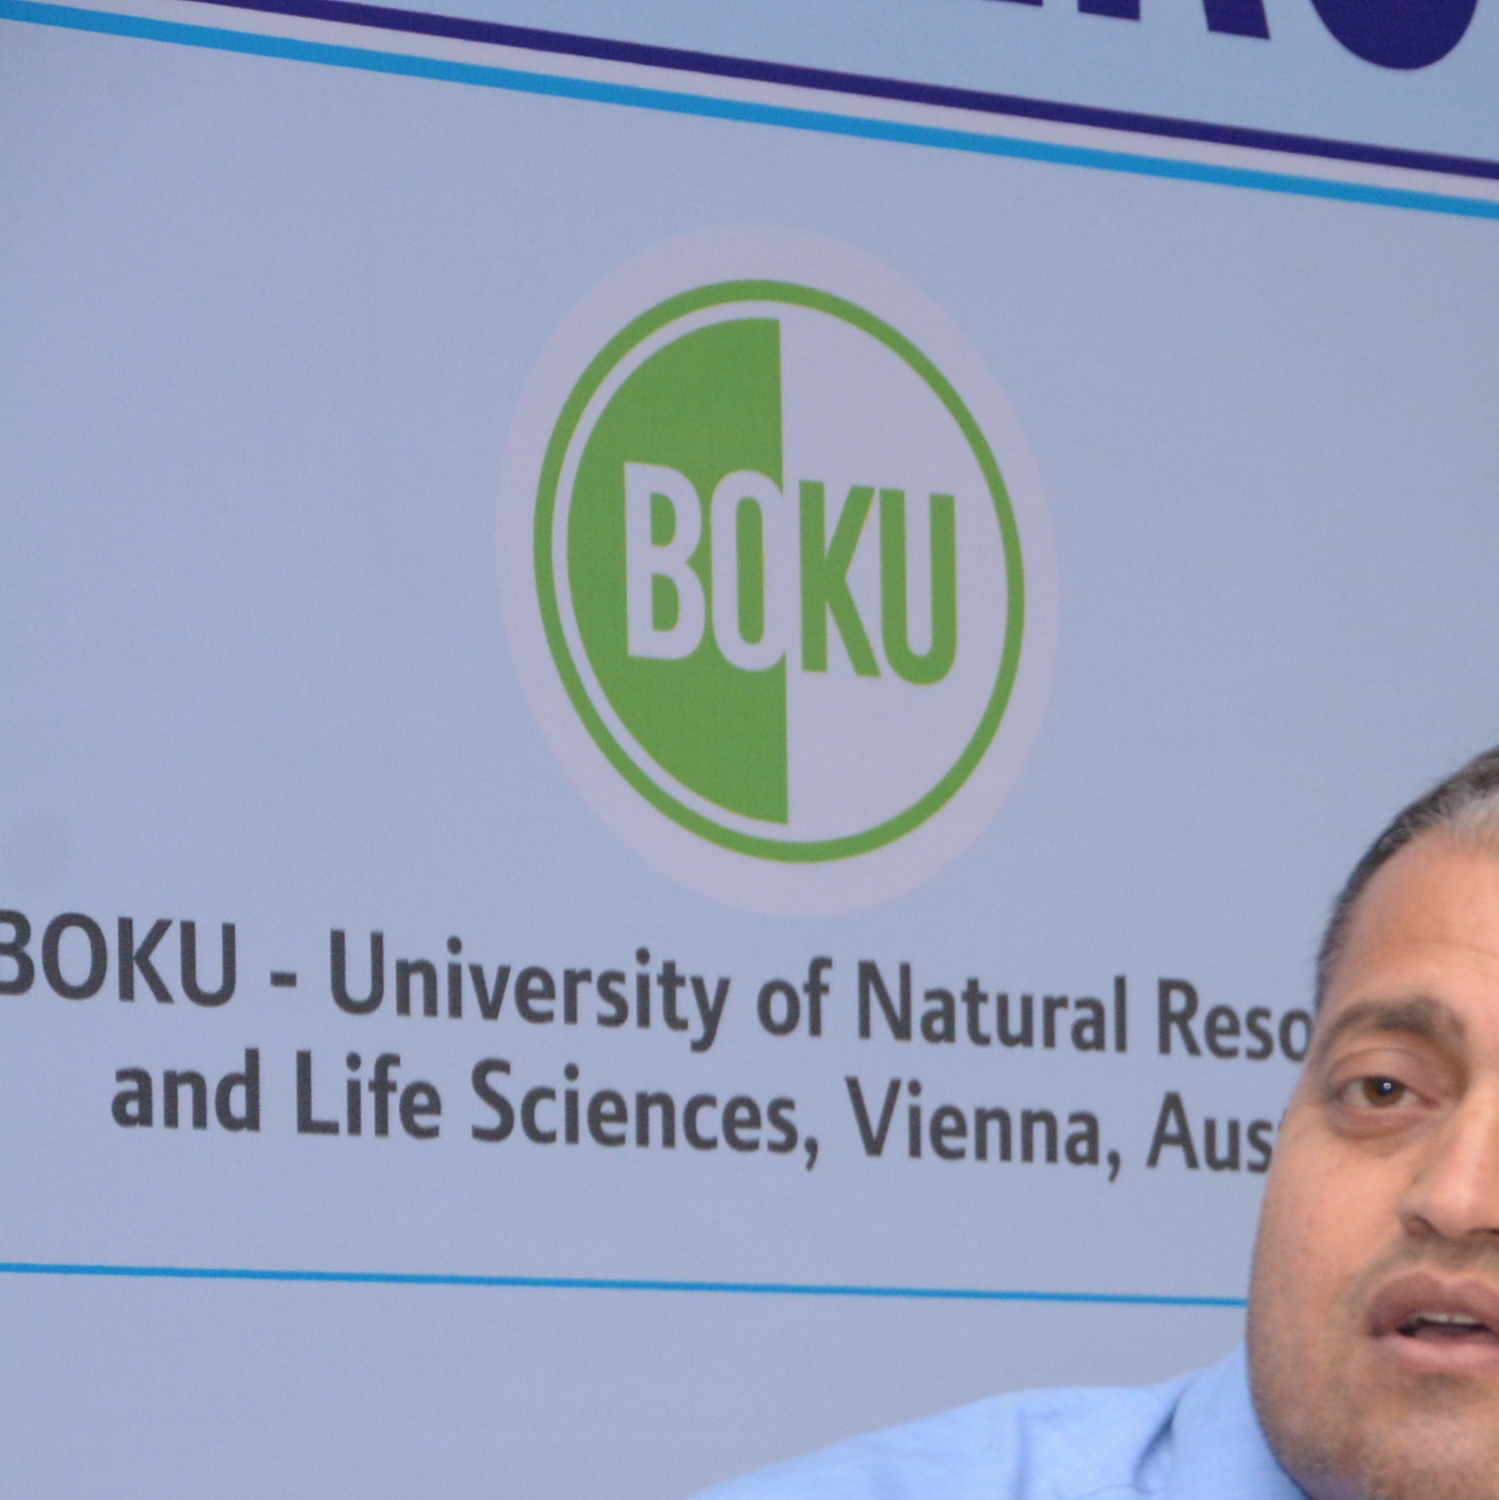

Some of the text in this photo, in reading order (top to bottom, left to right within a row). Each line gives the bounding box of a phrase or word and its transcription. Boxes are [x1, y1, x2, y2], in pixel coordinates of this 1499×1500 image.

[623, 461, 958, 686] BOKU
[0, 908, 1315, 1063] BOKU - University of Natural Reso
[111, 1046, 1284, 1184] and Life Sciences, Vienna, Aus
